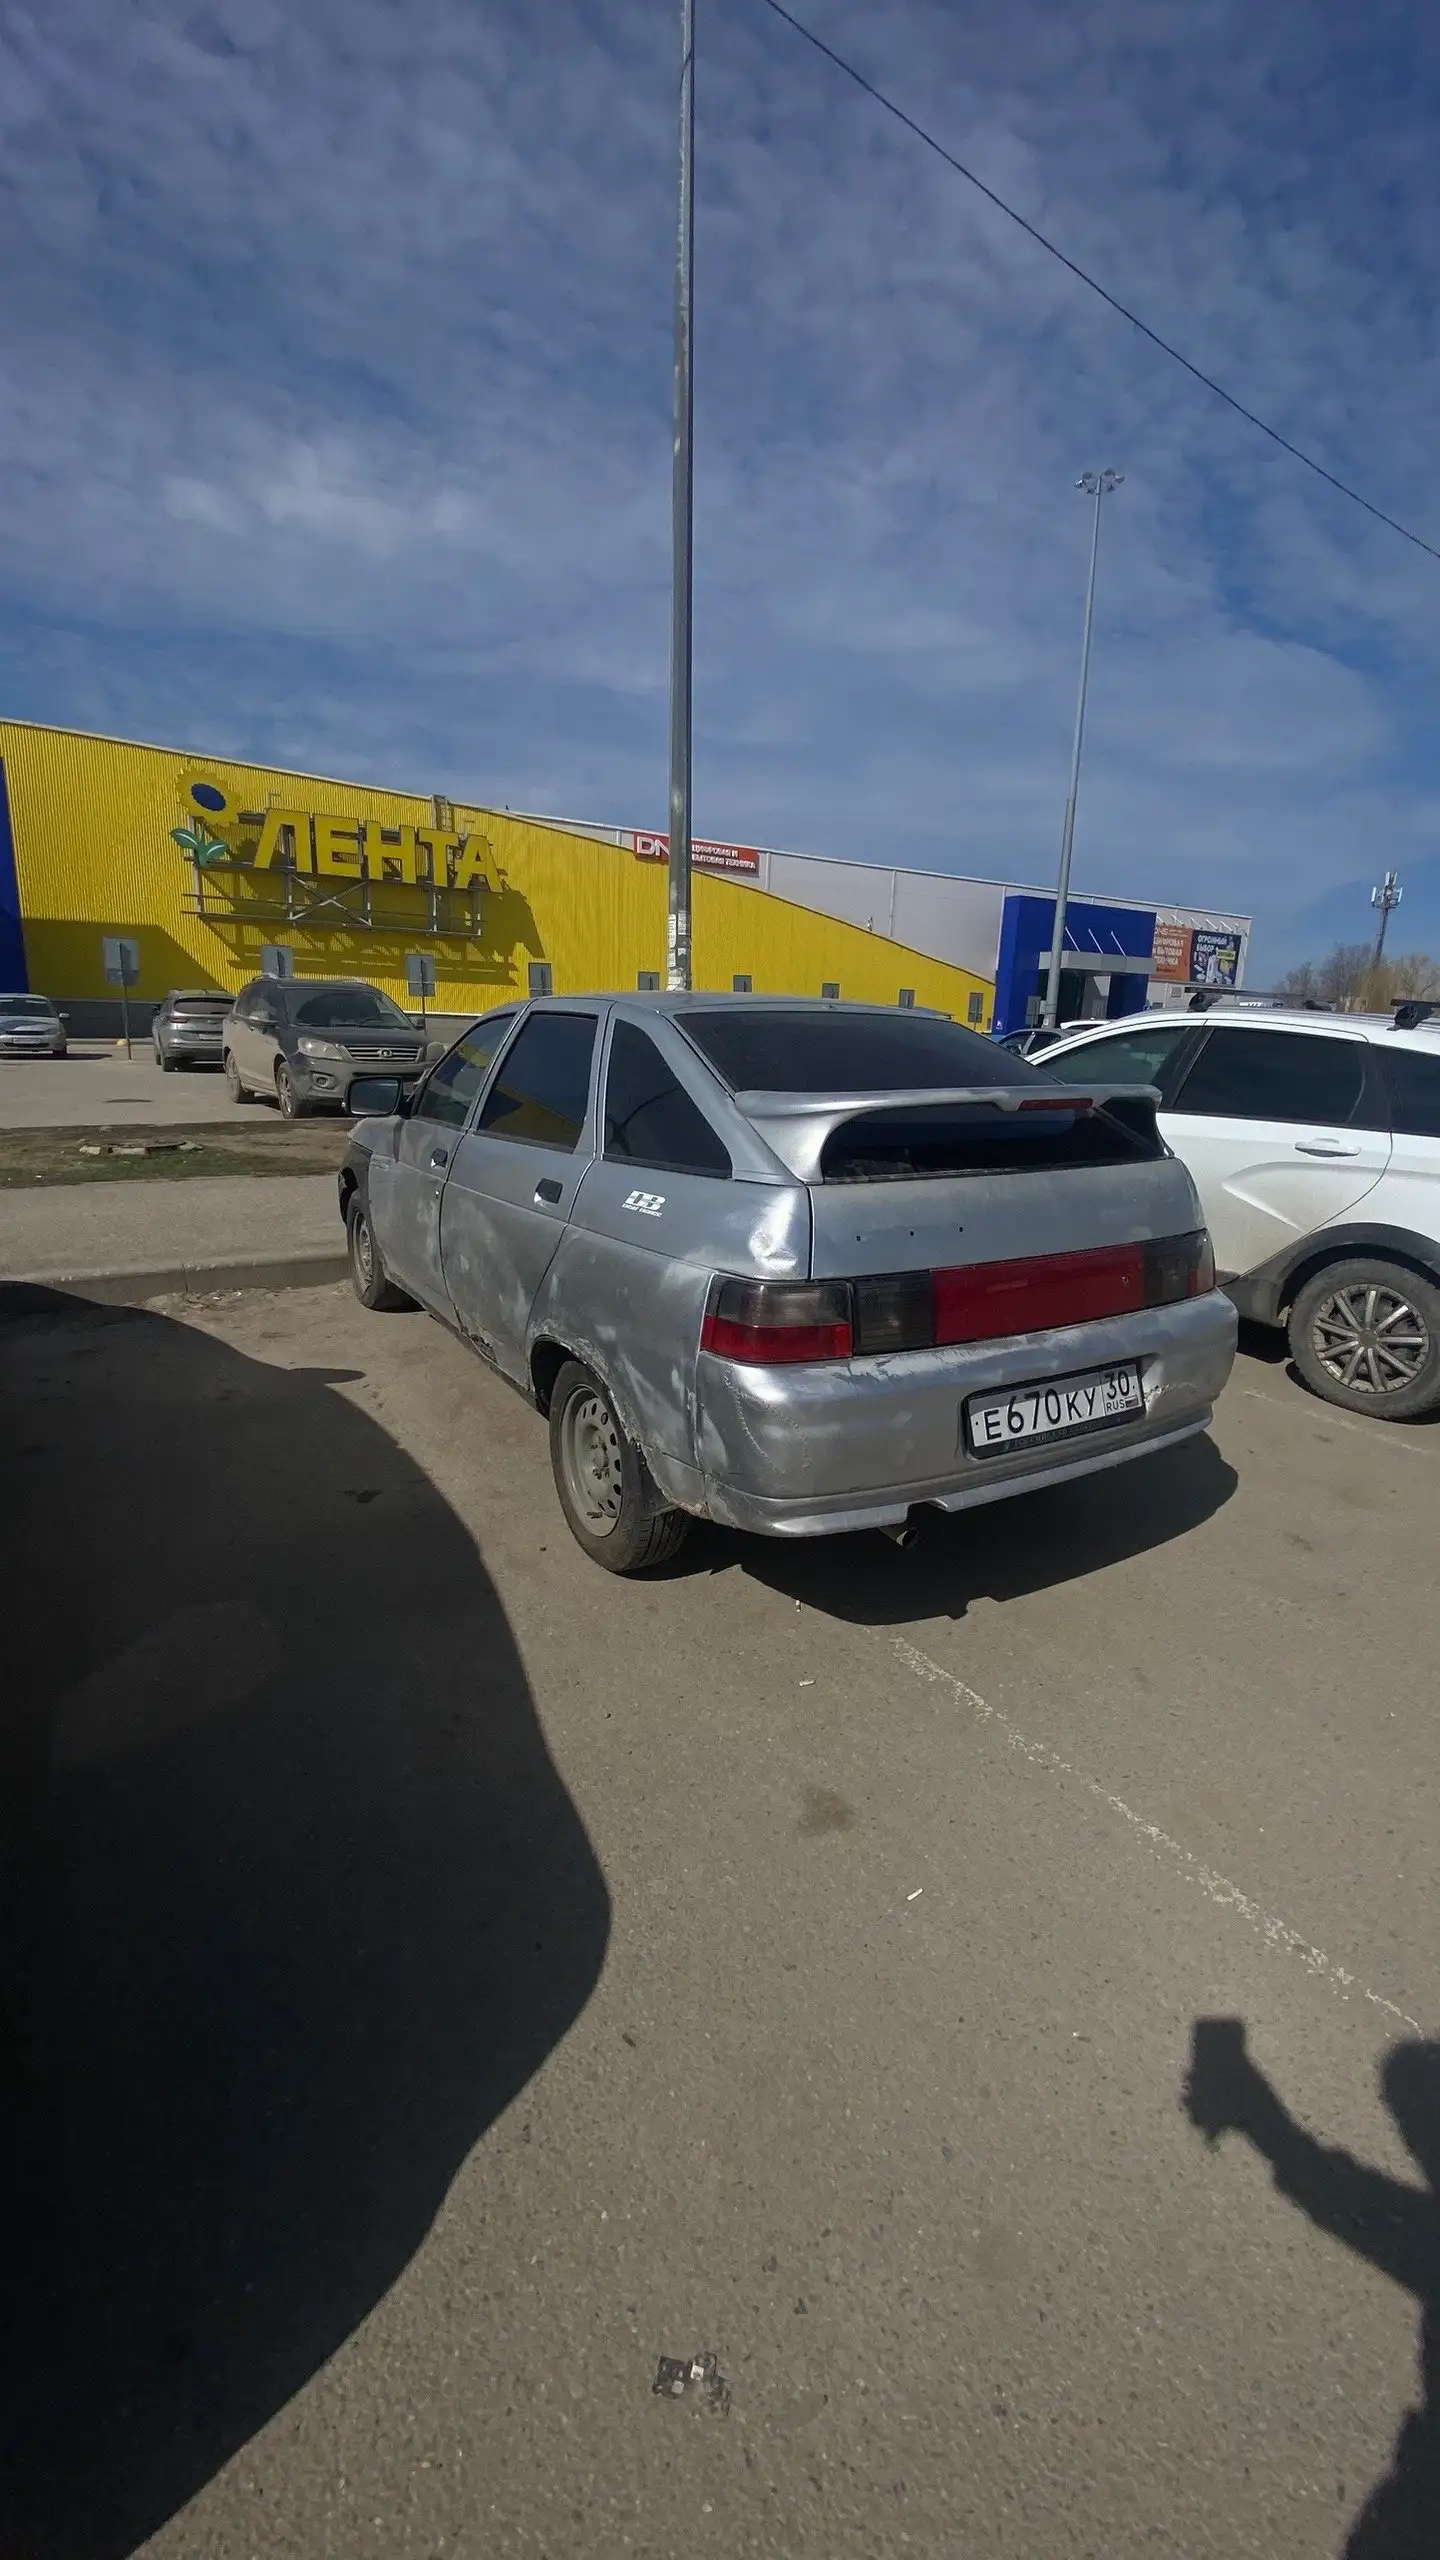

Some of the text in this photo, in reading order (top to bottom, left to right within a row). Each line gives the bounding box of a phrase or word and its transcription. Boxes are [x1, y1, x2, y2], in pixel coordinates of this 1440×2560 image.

[253, 808, 504, 892] ЛЕНТА
[636, 836, 670, 857] DN
[1104, 1370, 1130, 1400] 30
[1106, 1400, 1126, 1413] RUS
